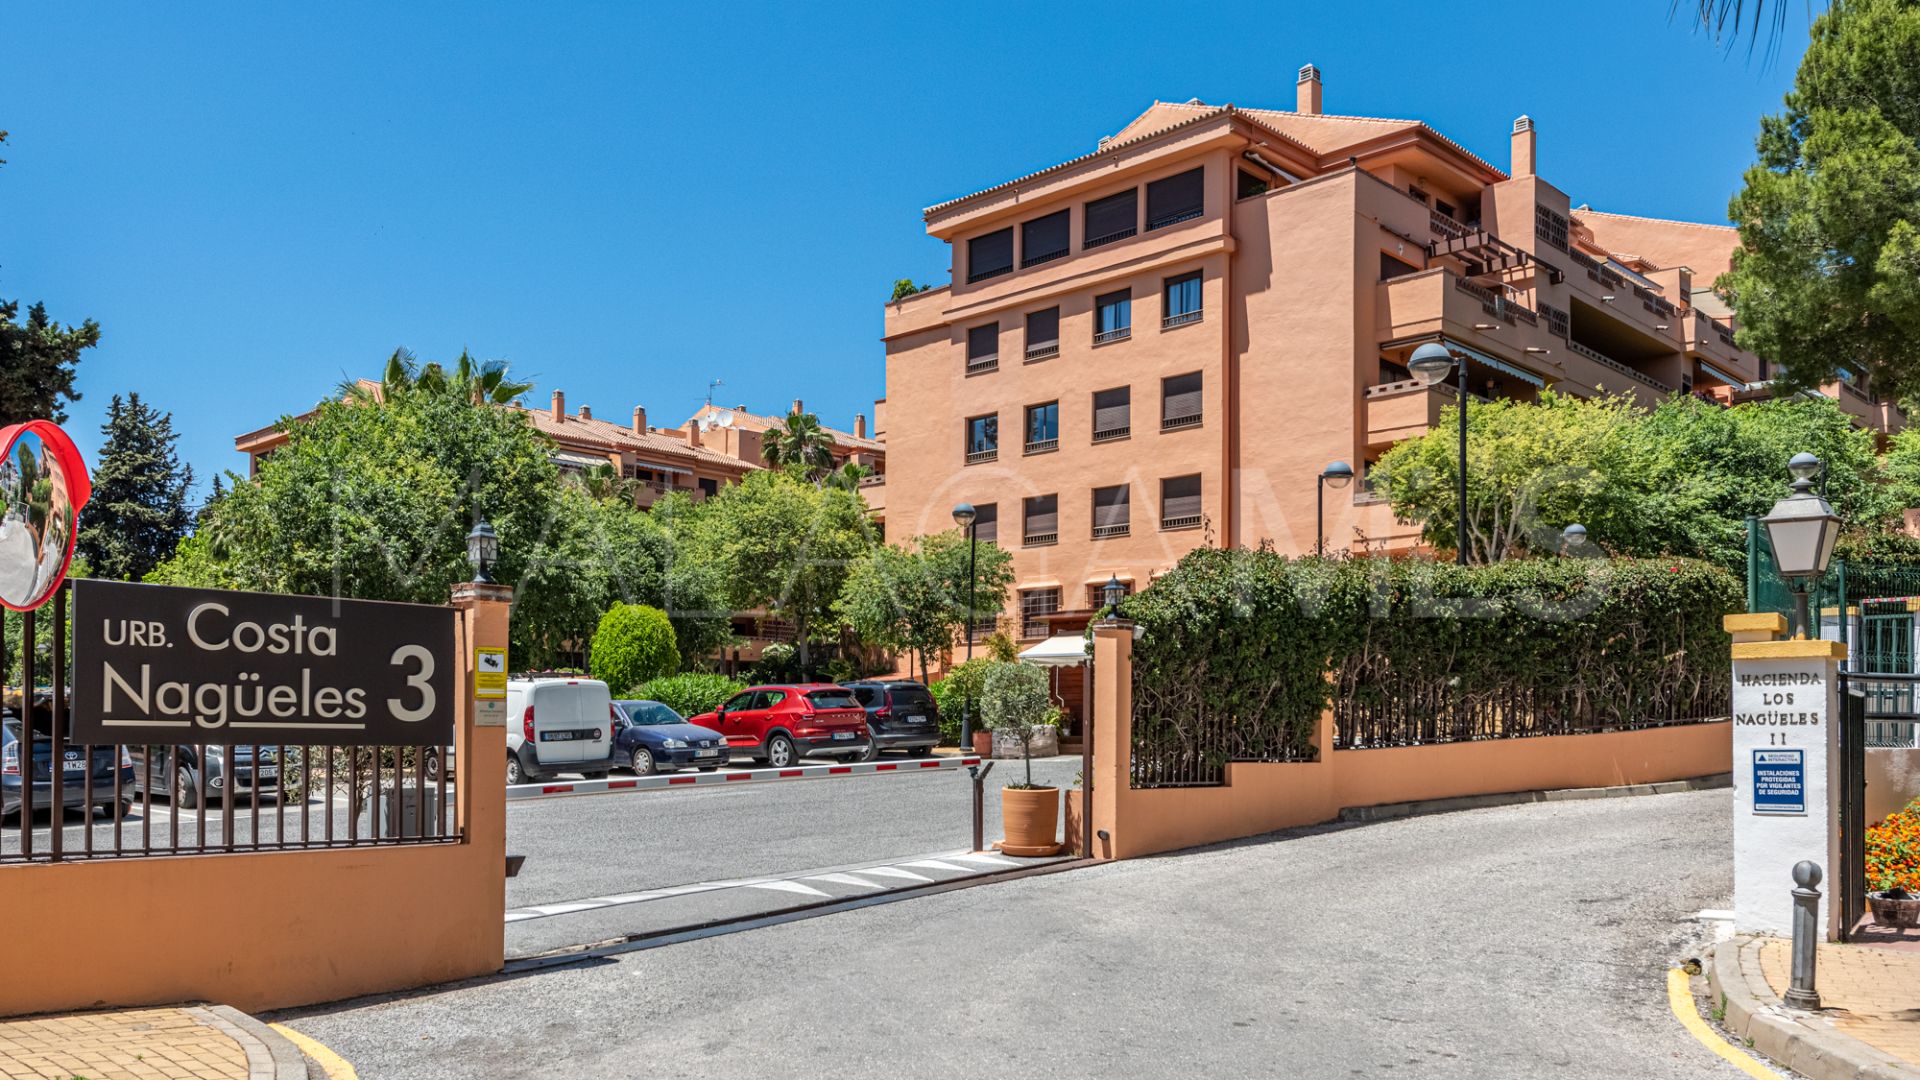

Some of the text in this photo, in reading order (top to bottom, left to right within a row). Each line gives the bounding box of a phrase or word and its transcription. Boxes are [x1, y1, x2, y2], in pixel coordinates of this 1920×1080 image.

[103, 602, 337, 656] URB. Costa
[103, 661, 367, 729] Nagüeles
[387, 644, 436, 722] 3
[1741, 672, 1822, 687] HACIENDA
[1763, 692, 1794, 706] LOS
[1736, 710, 1819, 726] NAGÜELES
